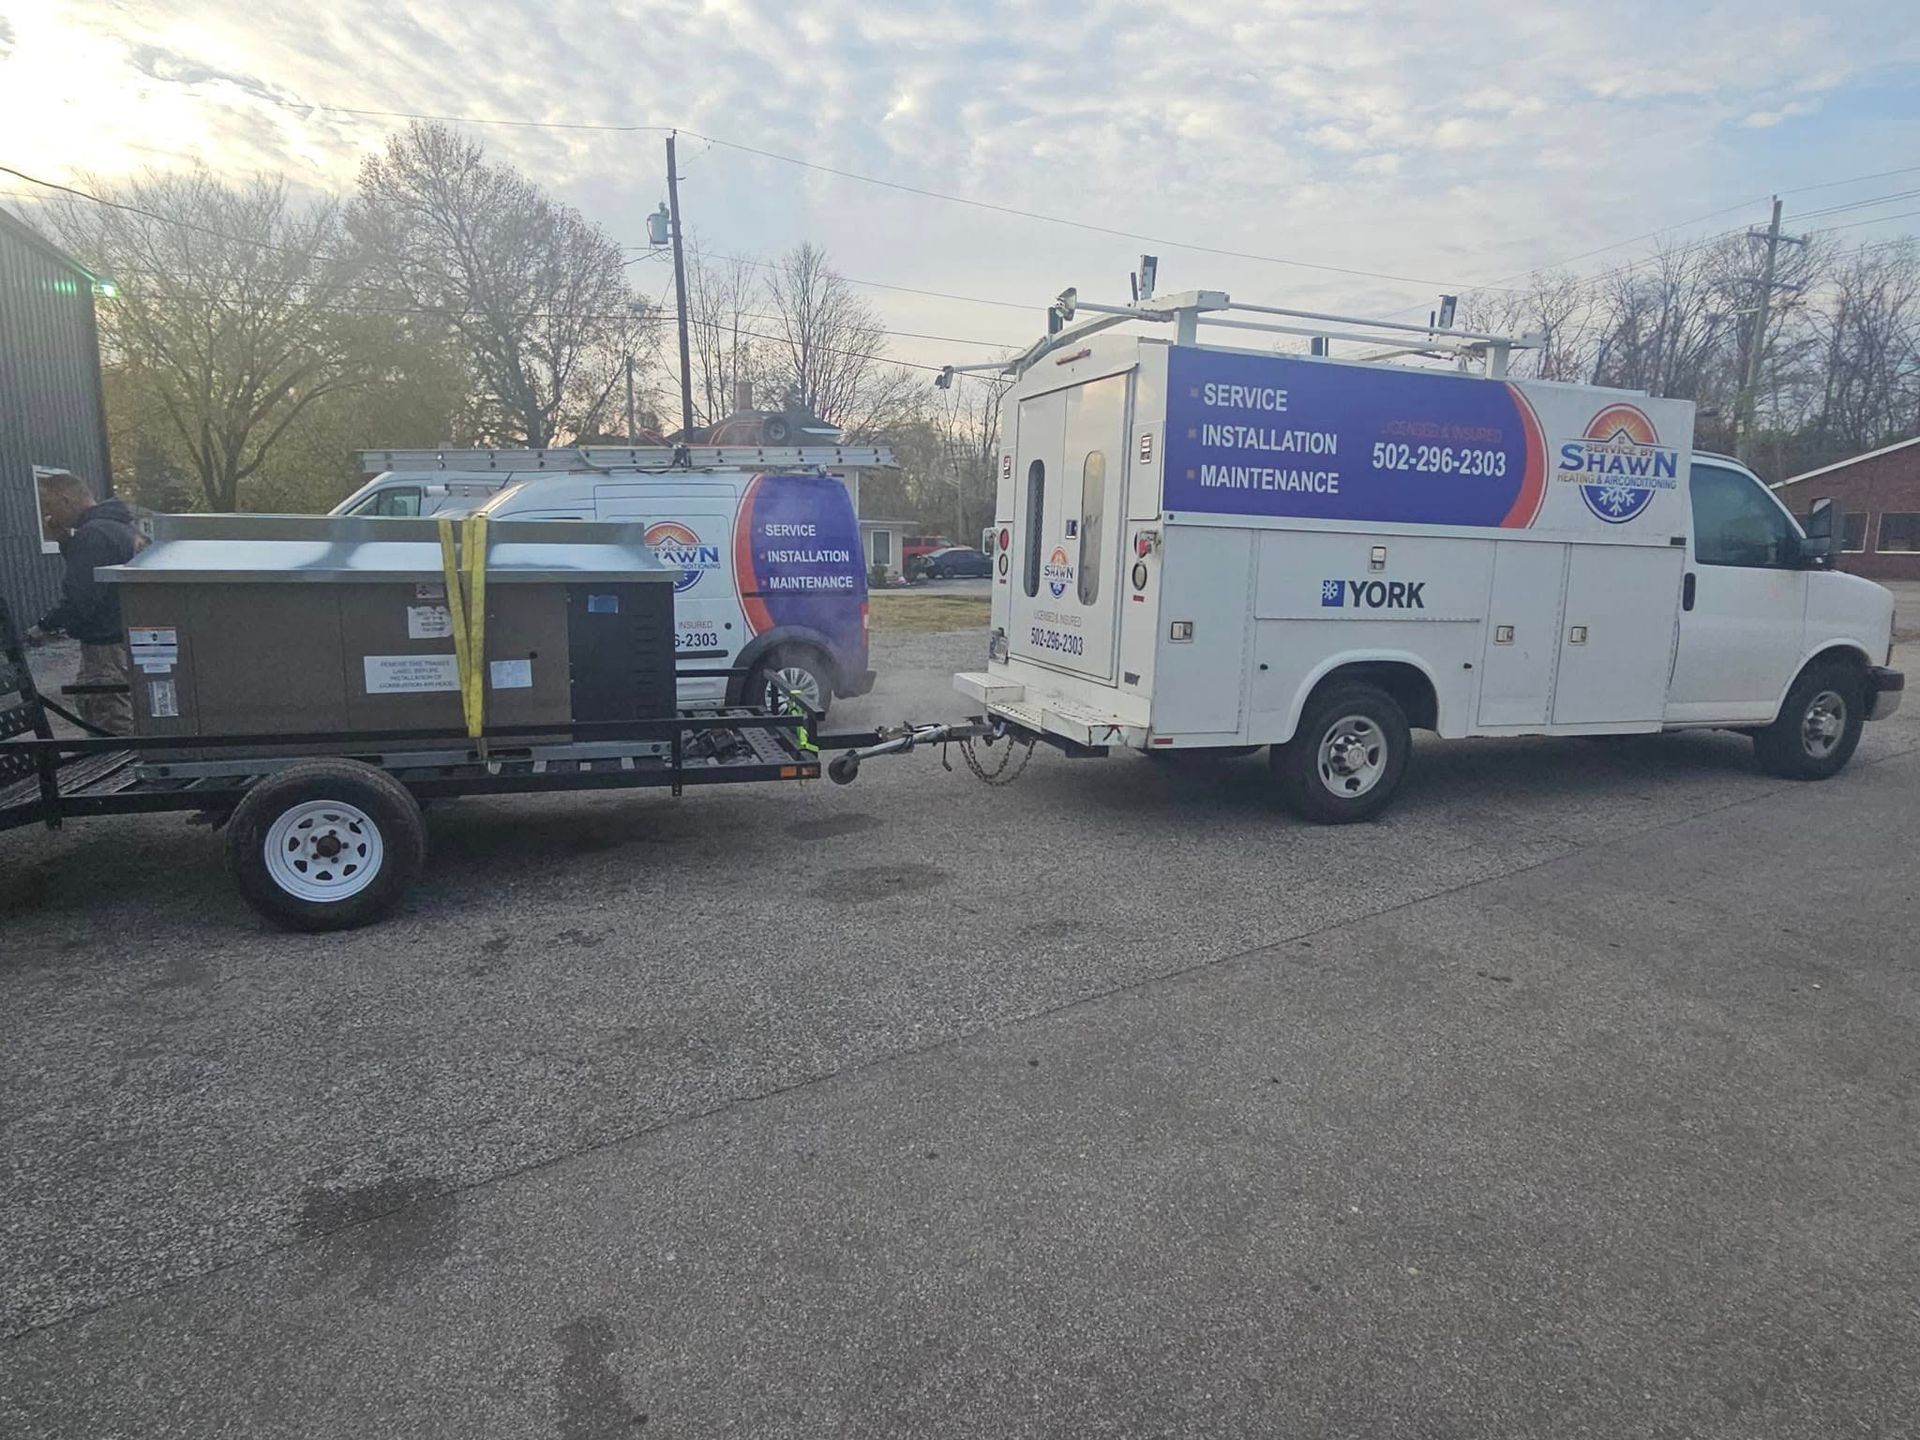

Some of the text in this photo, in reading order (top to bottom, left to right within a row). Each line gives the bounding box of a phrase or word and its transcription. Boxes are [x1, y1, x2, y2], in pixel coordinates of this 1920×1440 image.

[1203, 382, 1288, 411] SERVICE
[1202, 423, 1338, 455] INSTALLATION
[1585, 443, 1655, 457] SERVICE BY
[1372, 442, 1506, 477] 502-296-2303
[1558, 443, 1679, 478] SHAWN
[1200, 464, 1340, 494] MAINTENANCE
[1556, 473, 1595, 485] HEATING
[765, 524, 817, 537] SERVICE
[767, 550, 850, 563] INSTALLATION
[1044, 565, 1074, 579] SHAWN
[769, 576, 854, 589] MAINTENANCE
[1348, 580, 1426, 609] YORK
[679, 620, 713, 629] INSURED
[674, 632, 718, 648] 6-2303
[1031, 627, 1083, 656] 502-296-2303
